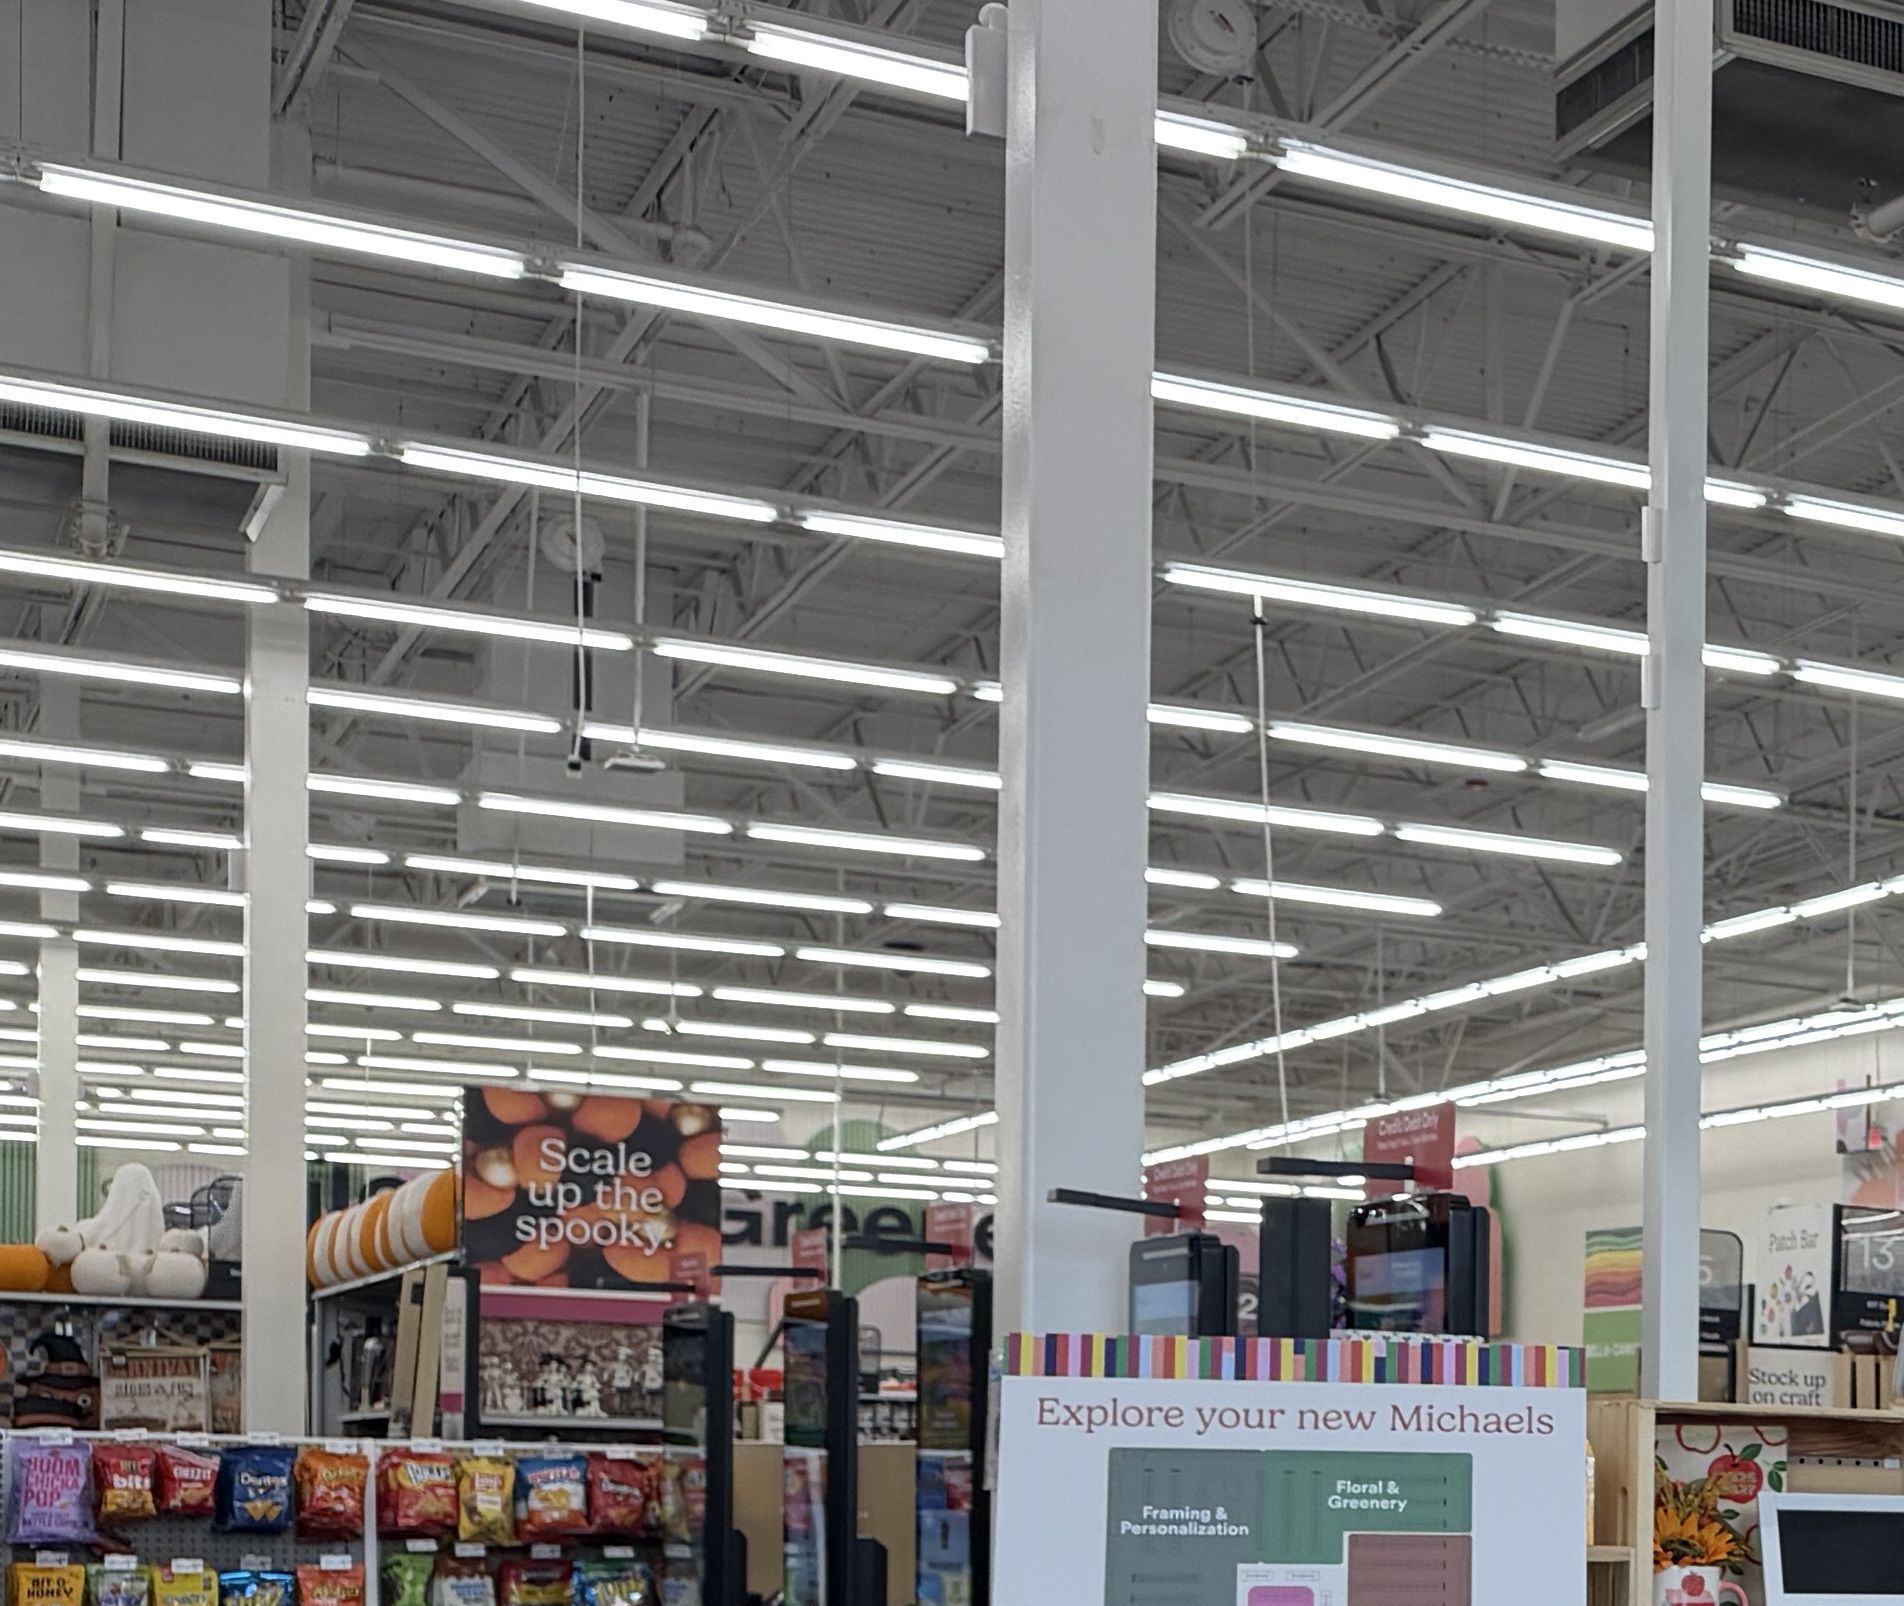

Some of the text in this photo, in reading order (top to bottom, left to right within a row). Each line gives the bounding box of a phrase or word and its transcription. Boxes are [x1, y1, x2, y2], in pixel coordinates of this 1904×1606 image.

[540, 1137, 653, 1177] Scale
[528, 1176, 664, 1216] up the
[515, 1212, 673, 1256] spooky.
[1768, 1230, 1798, 1252] Patch
[1749, 1368, 1826, 1391] Stock up
[1752, 1388, 1822, 1406] on craft
[1036, 1397, 1555, 1436] Explore your new Michaels
[1336, 1479, 1400, 1494] Floral &
[24, 1489, 61, 1507] POP
[1328, 1495, 1408, 1513] Greenery
[1142, 1505, 1228, 1523] Framing &
[1120, 1521, 1249, 1537] Personalization
